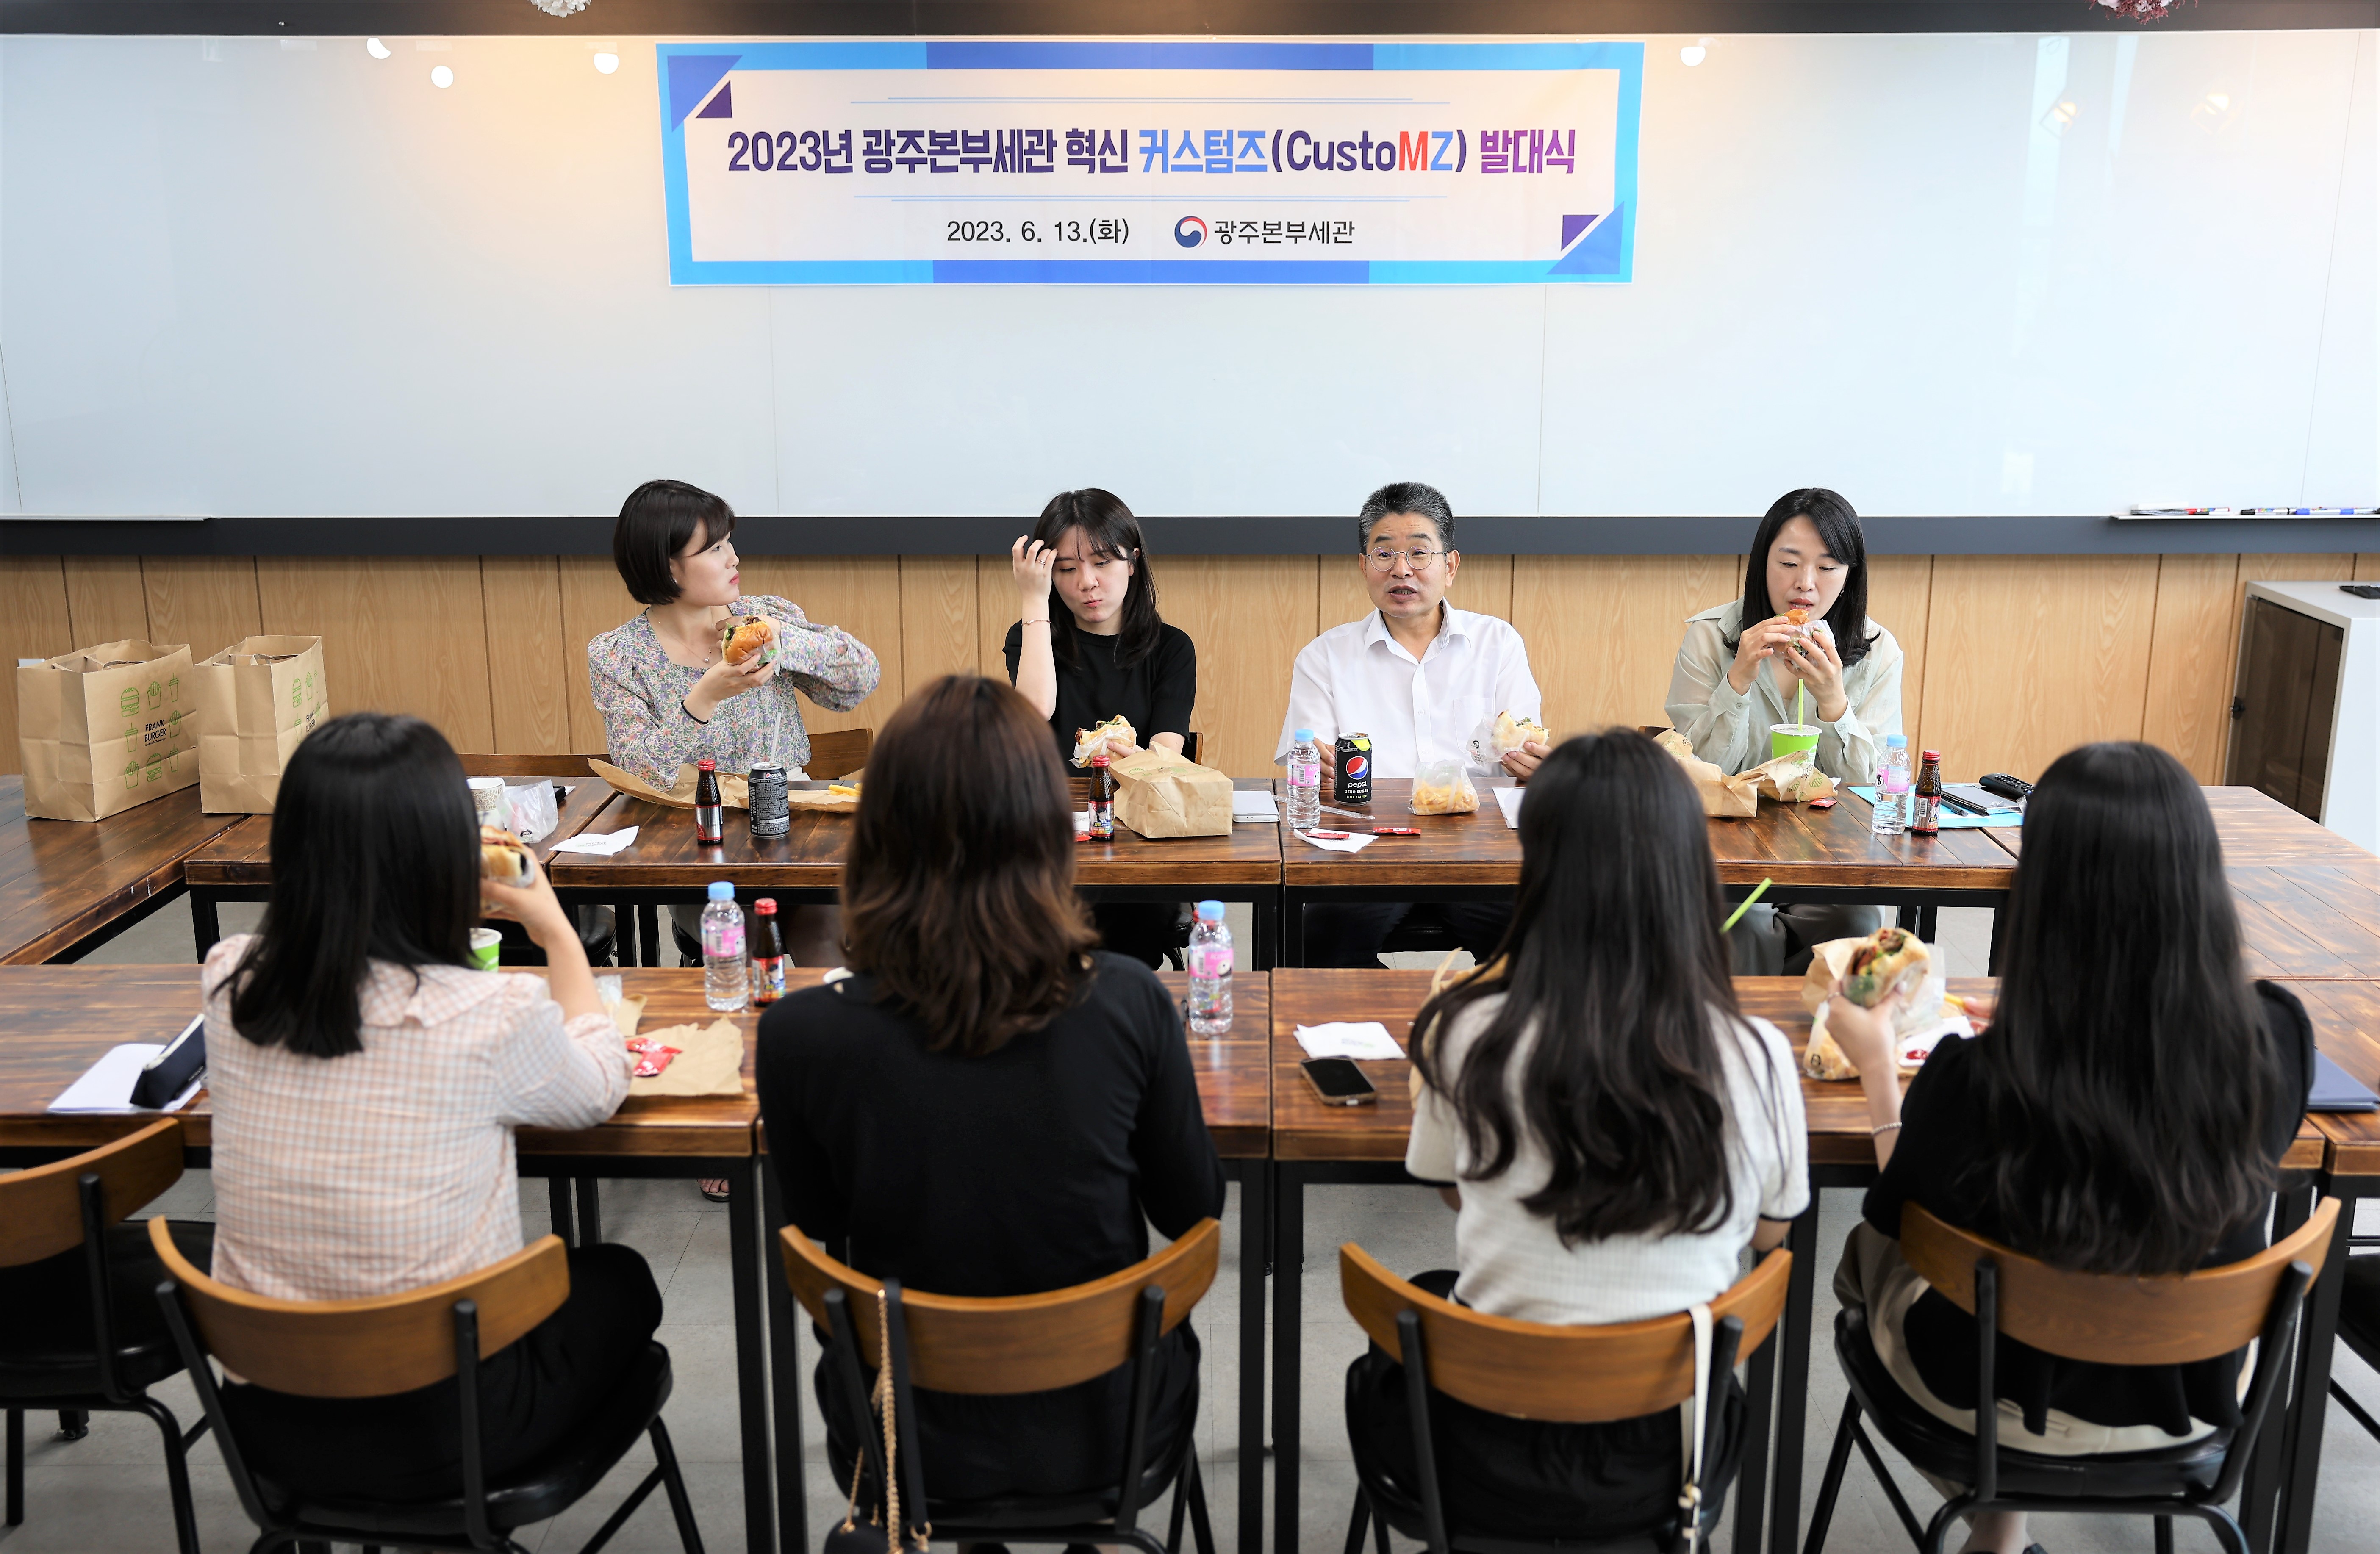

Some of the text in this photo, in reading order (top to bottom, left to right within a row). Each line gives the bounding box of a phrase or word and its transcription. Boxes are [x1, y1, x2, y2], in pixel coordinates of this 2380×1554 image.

[728, 128, 1576, 174] 2023년 광주본부세관 혁신 커스텀즈(CustoMZ) 발대식
[947, 217, 1129, 244] 2023. 6. 13.(화)
[1214, 220, 1355, 245] 광주본부세관
[144, 728, 166, 742] BURGER
[145, 719, 165, 732] FRANK
[1348, 780, 1367, 789] pepsi
